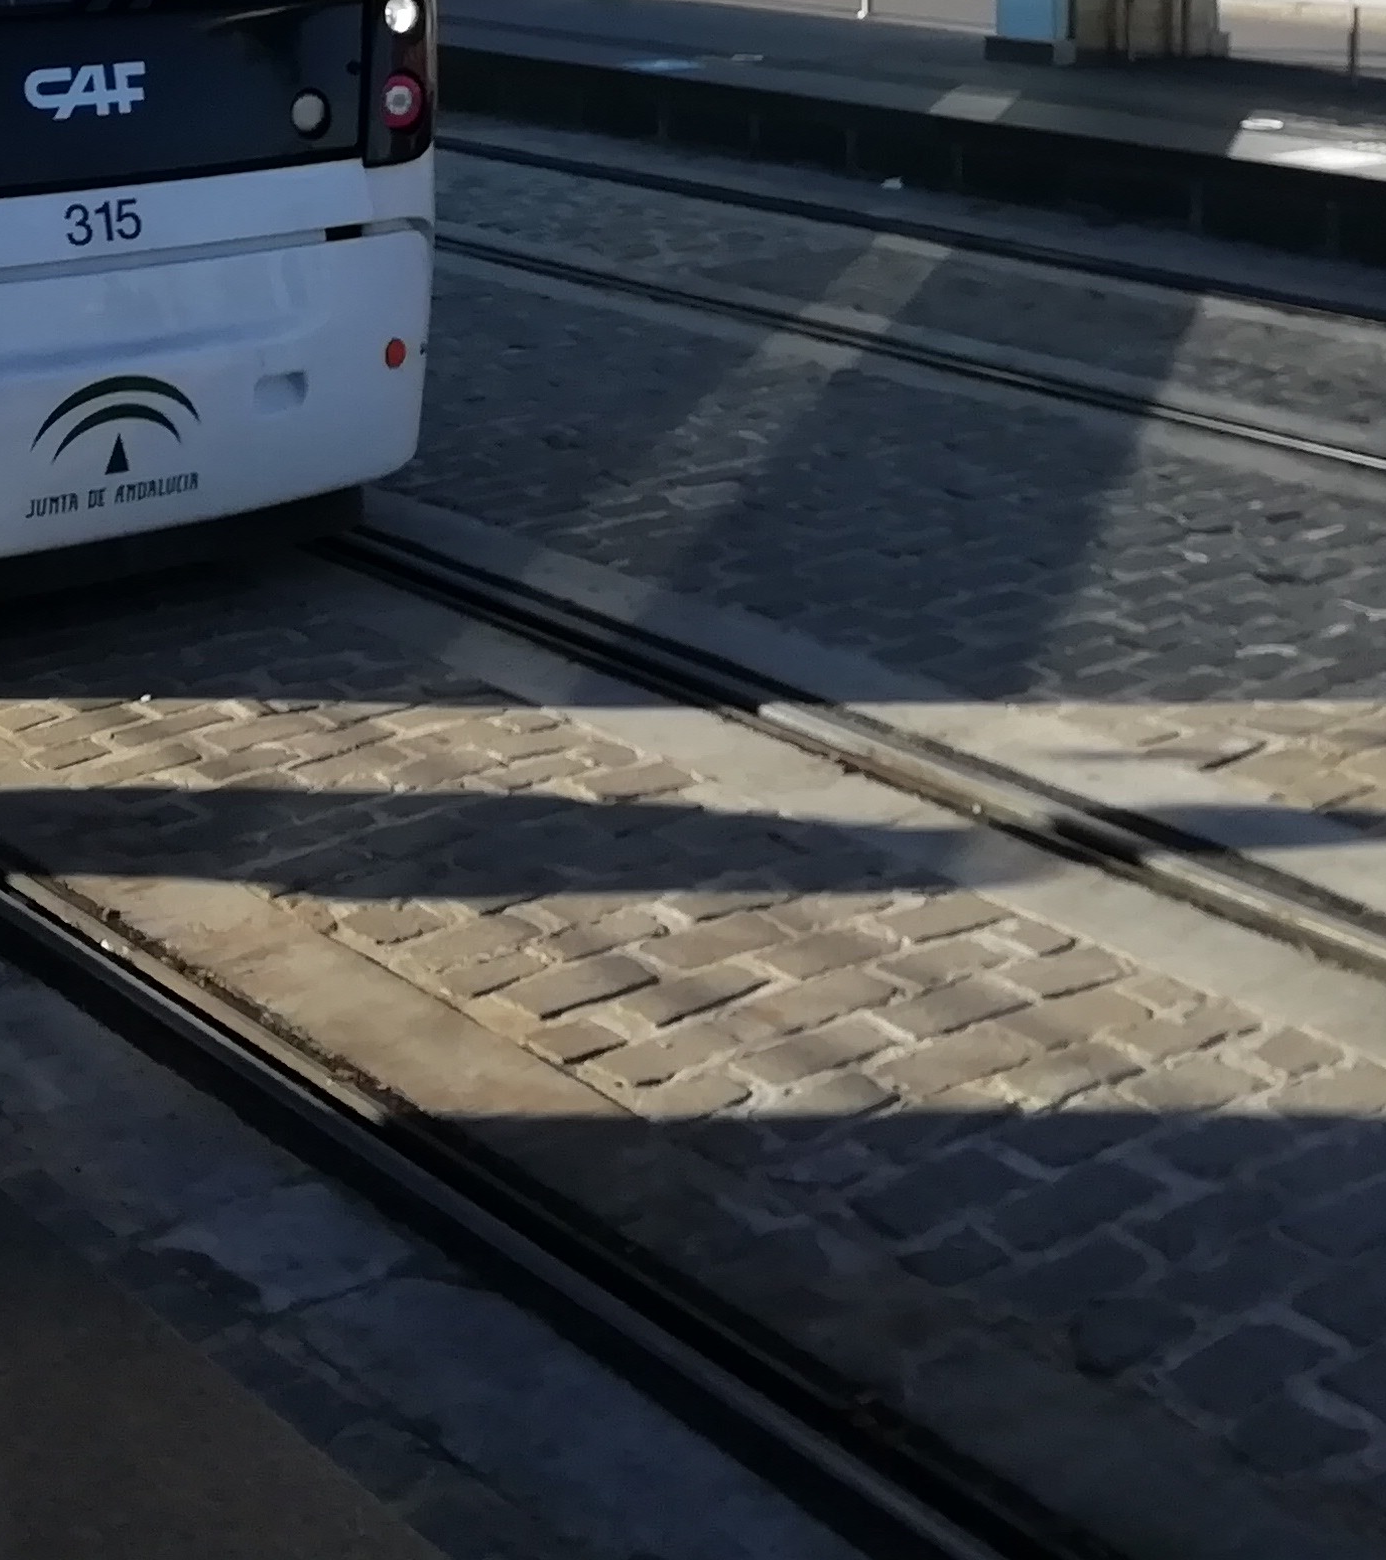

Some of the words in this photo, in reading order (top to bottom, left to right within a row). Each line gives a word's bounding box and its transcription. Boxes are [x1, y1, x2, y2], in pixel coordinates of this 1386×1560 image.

[23, 60, 146, 121] CAF
[63, 197, 142, 247] 315
[25, 491, 80, 519] JUNTA
[87, 486, 108, 509] DE
